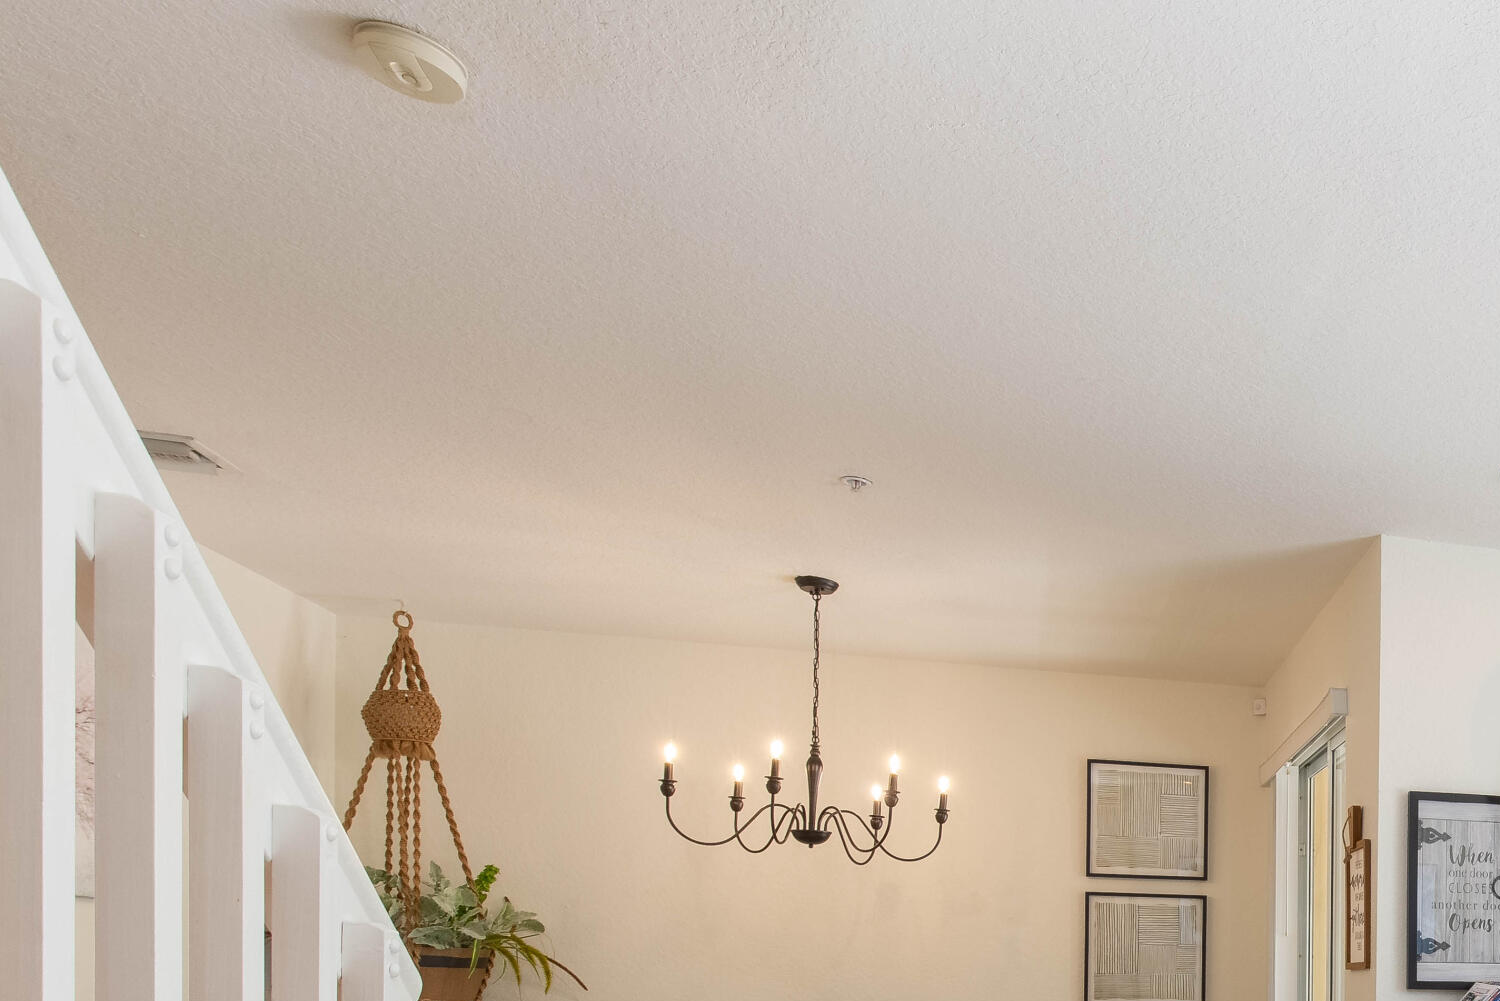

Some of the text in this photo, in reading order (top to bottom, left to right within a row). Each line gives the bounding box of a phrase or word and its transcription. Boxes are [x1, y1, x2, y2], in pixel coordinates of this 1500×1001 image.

[1449, 843, 1495, 867] When
[1448, 867, 1494, 880] one door
[1448, 882, 1494, 895] CLOSES
[1431, 899, 1478, 911] another
[1448, 912, 1494, 935] Opens
